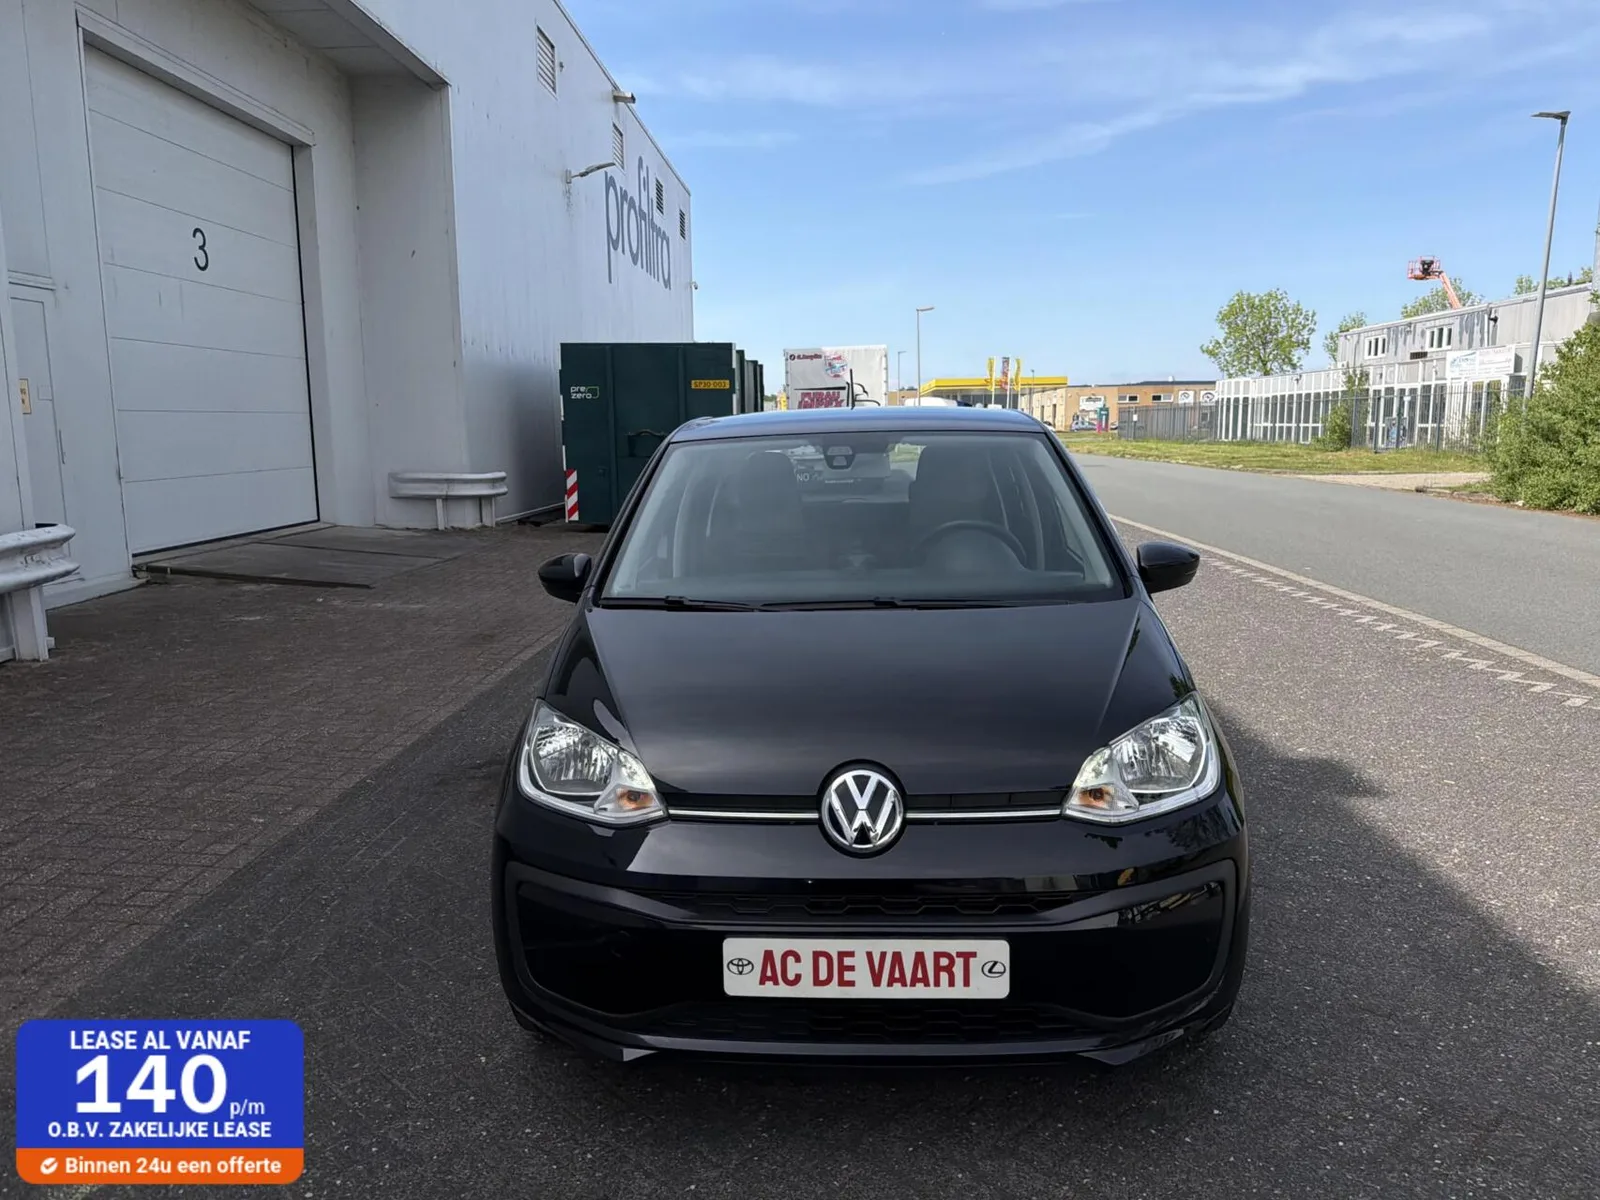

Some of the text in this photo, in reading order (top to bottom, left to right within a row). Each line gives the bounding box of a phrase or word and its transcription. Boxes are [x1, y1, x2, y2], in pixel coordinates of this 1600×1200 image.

[604, 156, 672, 291] profiltra
[192, 227, 209, 272] 3
[759, 949, 978, 988] AC DE VAART
